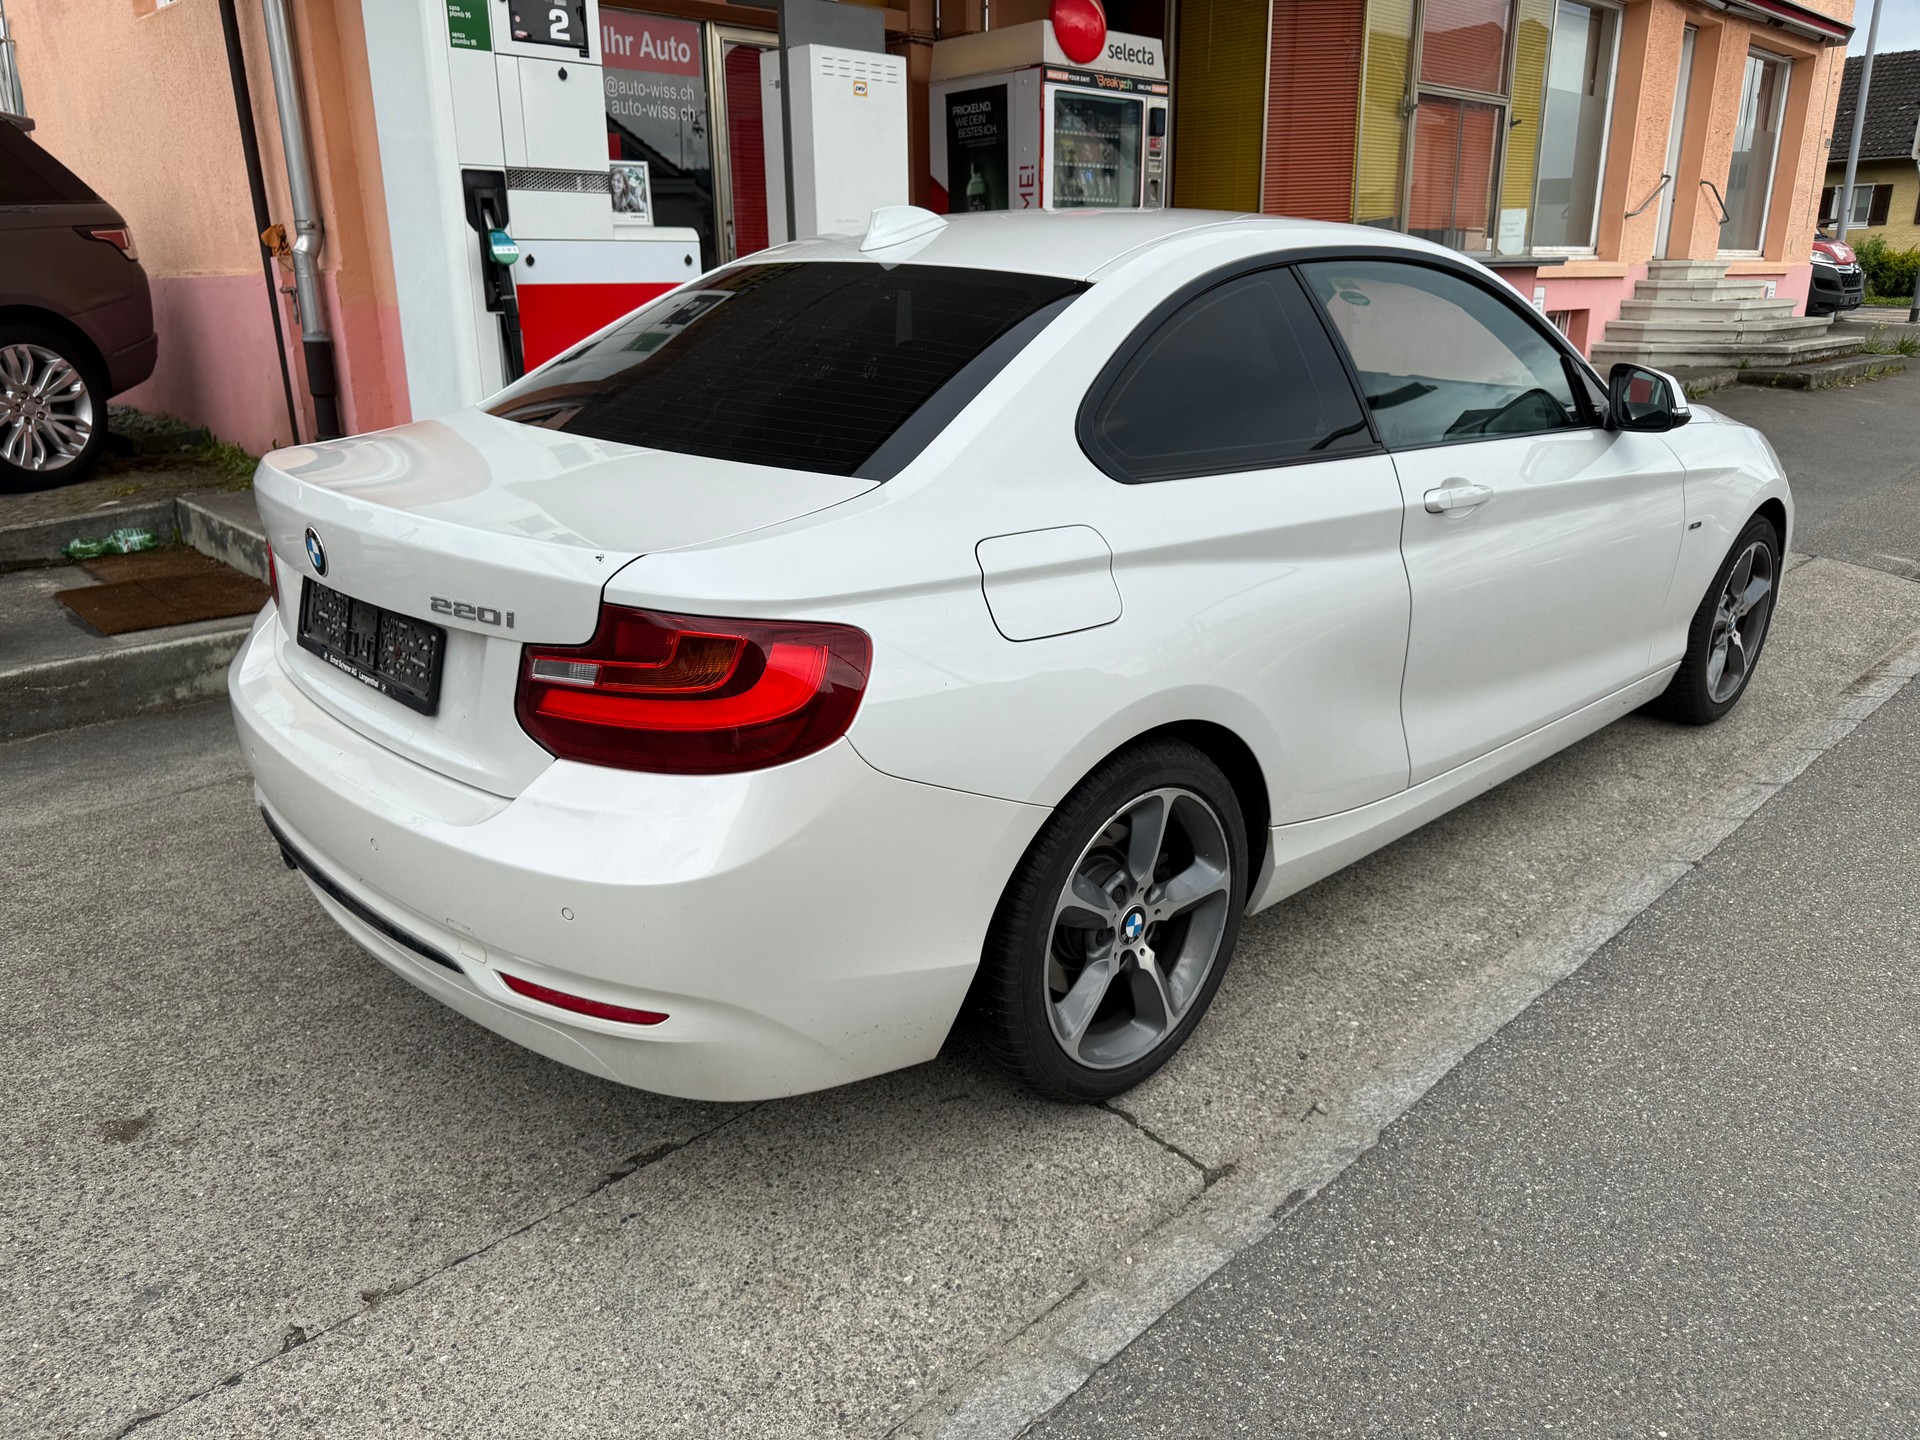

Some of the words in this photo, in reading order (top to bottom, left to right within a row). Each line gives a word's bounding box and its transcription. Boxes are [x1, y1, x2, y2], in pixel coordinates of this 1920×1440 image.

[549, 8, 570, 41] 2
[603, 25, 634, 56] Ihr
[639, 31, 691, 63] Auto
[1107, 43, 1155, 66] selecta
[604, 76, 695, 101] @auto-wiss.ch
[611, 98, 696, 122] auto-wiss.ch
[952, 101, 993, 116] PRICKELND,
[430, 595, 515, 629] 220i
